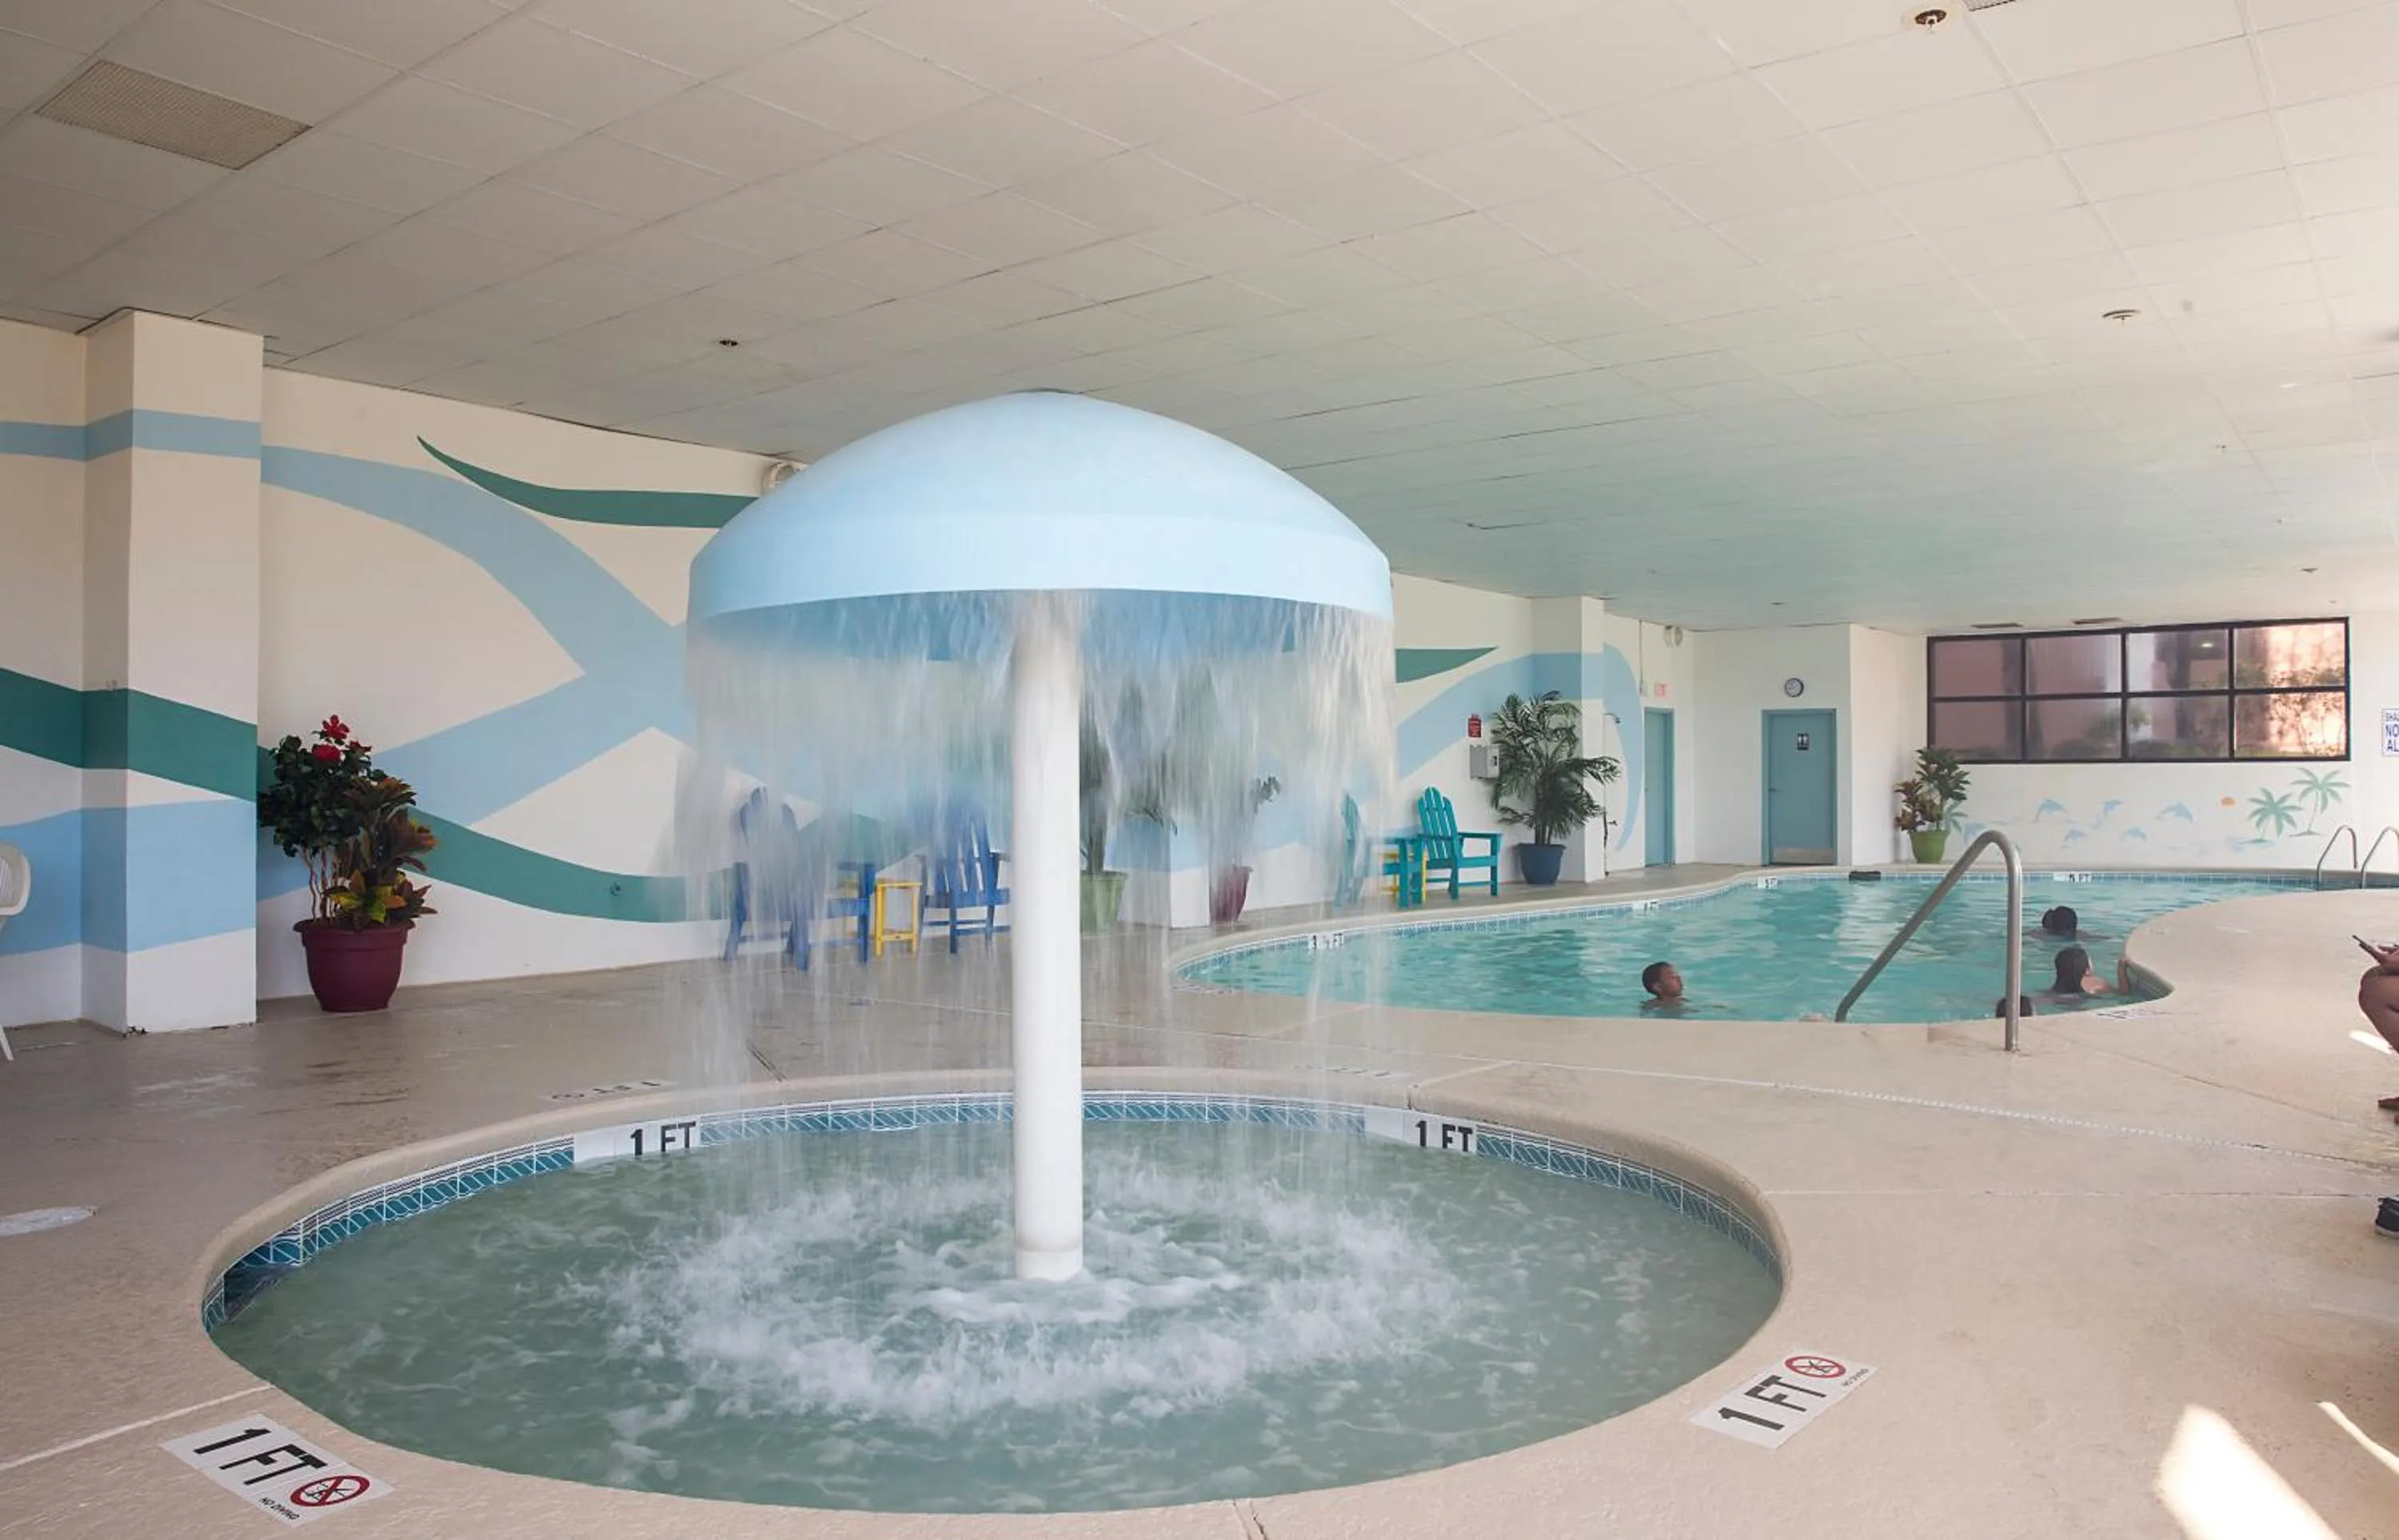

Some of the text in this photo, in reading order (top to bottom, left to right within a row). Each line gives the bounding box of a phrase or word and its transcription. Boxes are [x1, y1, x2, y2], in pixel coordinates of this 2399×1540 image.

[630, 1121, 697, 1155] 1 FT
[1415, 1120, 1473, 1151] 1 FT
[1743, 1374, 1826, 1413] FT
[1718, 1406, 1784, 1430] 1
[193, 1428, 328, 1486] 1 FT
